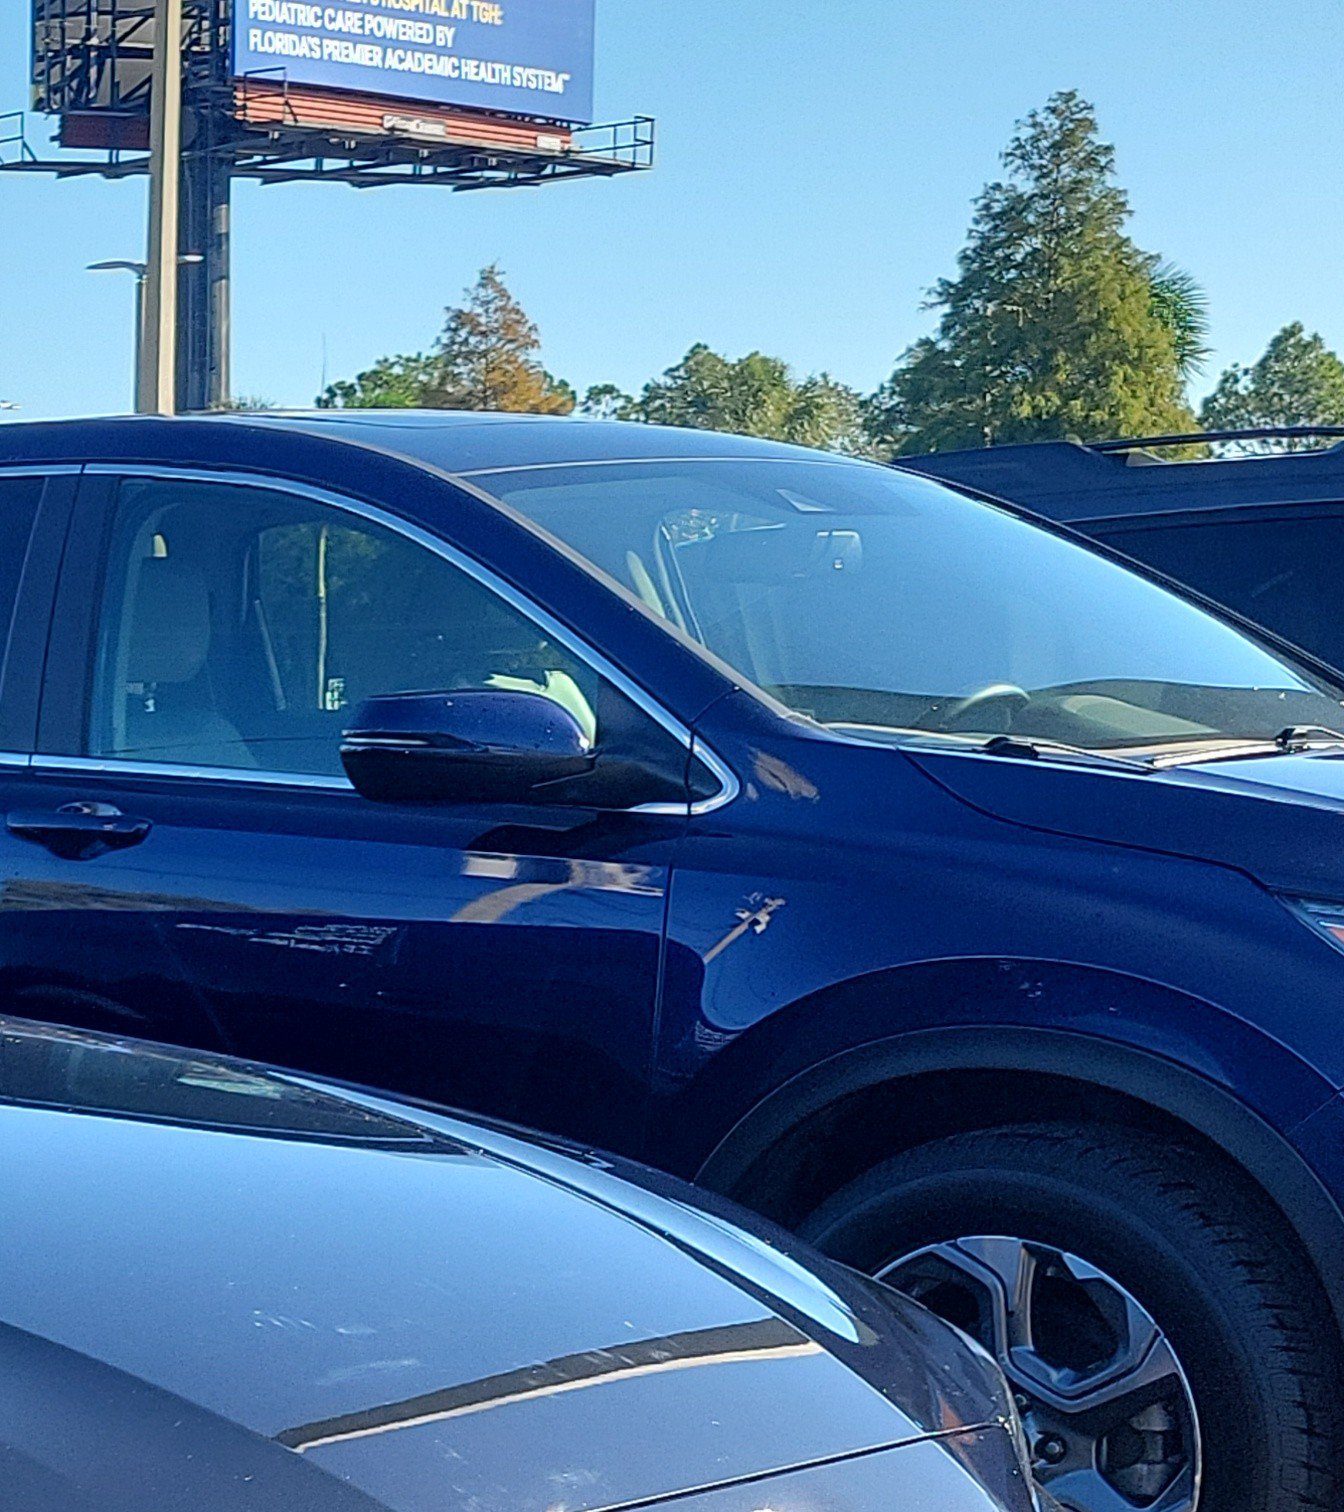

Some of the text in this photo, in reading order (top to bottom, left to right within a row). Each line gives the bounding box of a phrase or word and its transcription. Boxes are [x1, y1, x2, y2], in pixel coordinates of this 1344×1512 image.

[248, 0, 456, 47] PEDIATRIC CARE POWERED BY
[450, 0, 468, 20] AT
[248, 28, 321, 59] FLORIDA'S
[322, 38, 383, 68] PREMIER
[384, 47, 460, 79] ACADEMIC
[461, 58, 511, 86] HEALTH
